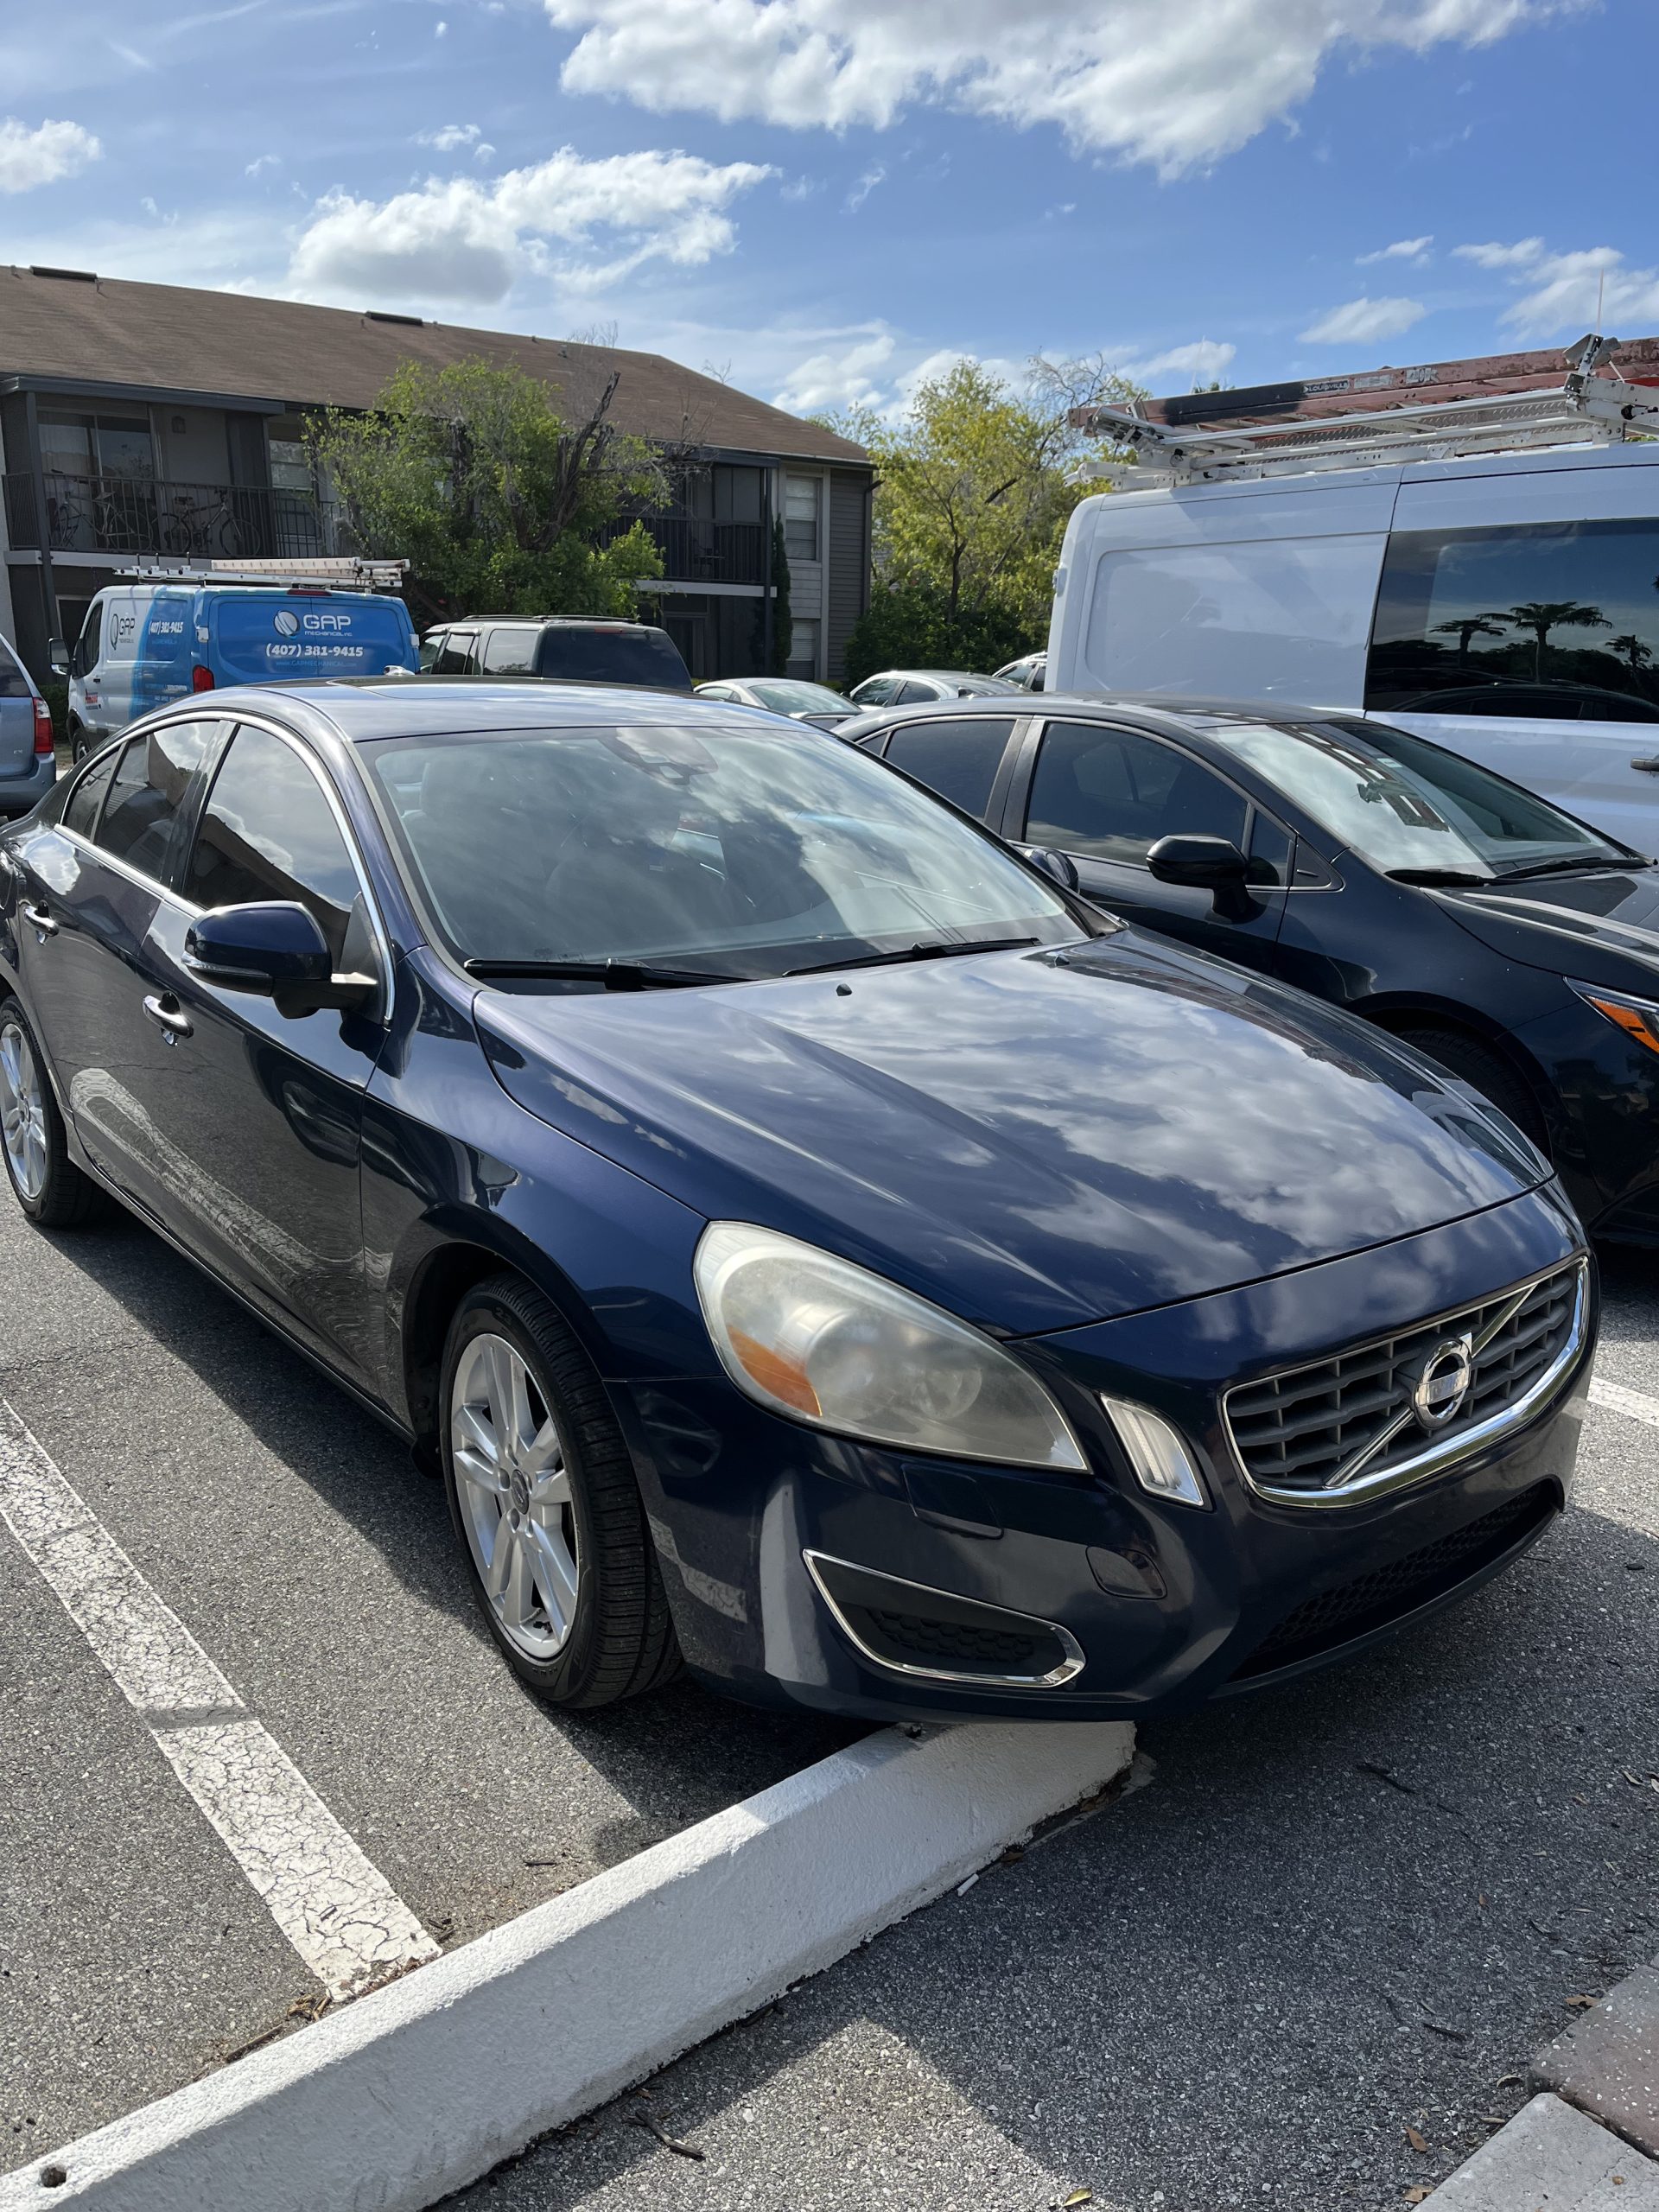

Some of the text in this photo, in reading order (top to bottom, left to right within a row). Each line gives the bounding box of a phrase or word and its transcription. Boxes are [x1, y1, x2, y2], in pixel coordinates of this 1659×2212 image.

[119, 618, 136, 635] GAP
[302, 614, 352, 631] GAP
[265, 643, 364, 658] (407) 381-9415
